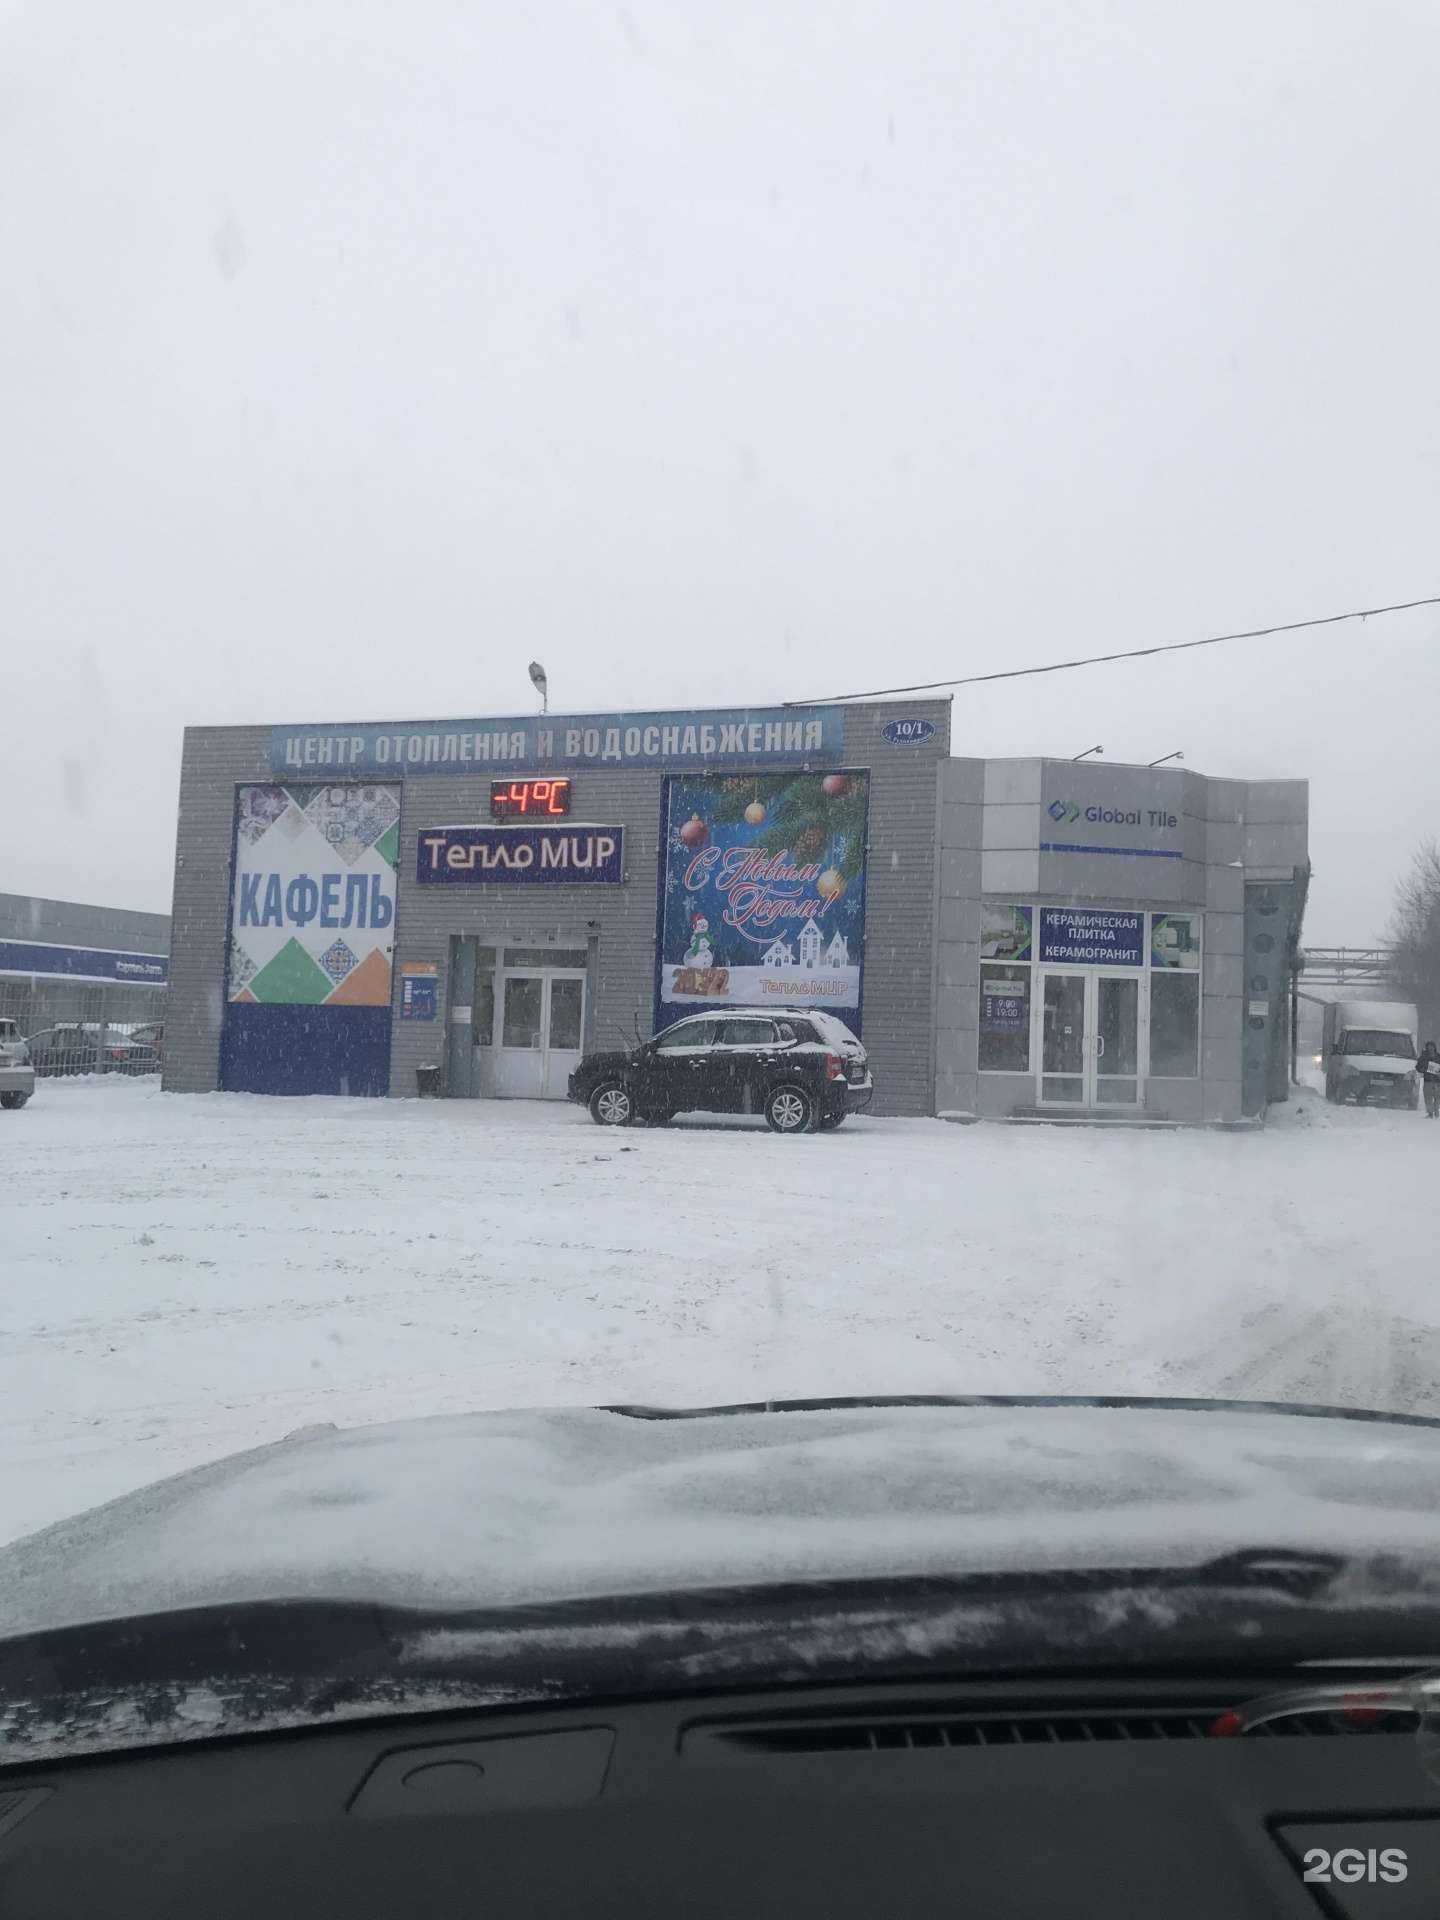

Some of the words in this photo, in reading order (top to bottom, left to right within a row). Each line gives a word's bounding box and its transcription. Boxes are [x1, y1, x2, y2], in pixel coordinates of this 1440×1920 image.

[896, 720, 922, 737] 10/1
[285, 736, 365, 768] ЦЕНТР
[375, 731, 526, 763] ОТОПЛЕНИЯ
[537, 729, 553, 758] И
[565, 720, 823, 761] ВОДОСНАБЖЕНИЯ
[1085, 806, 1141, 825] Global
[1147, 811, 1178, 828] Tile
[239, 872, 393, 929] КАФЕЛЬ
[1046, 914, 1138, 929] КЕРАМИЧЕСКАЯ
[1068, 928, 1116, 941] ПЛИТКА
[1045, 945, 1138, 960] КЕРАМОГРАНИТ
